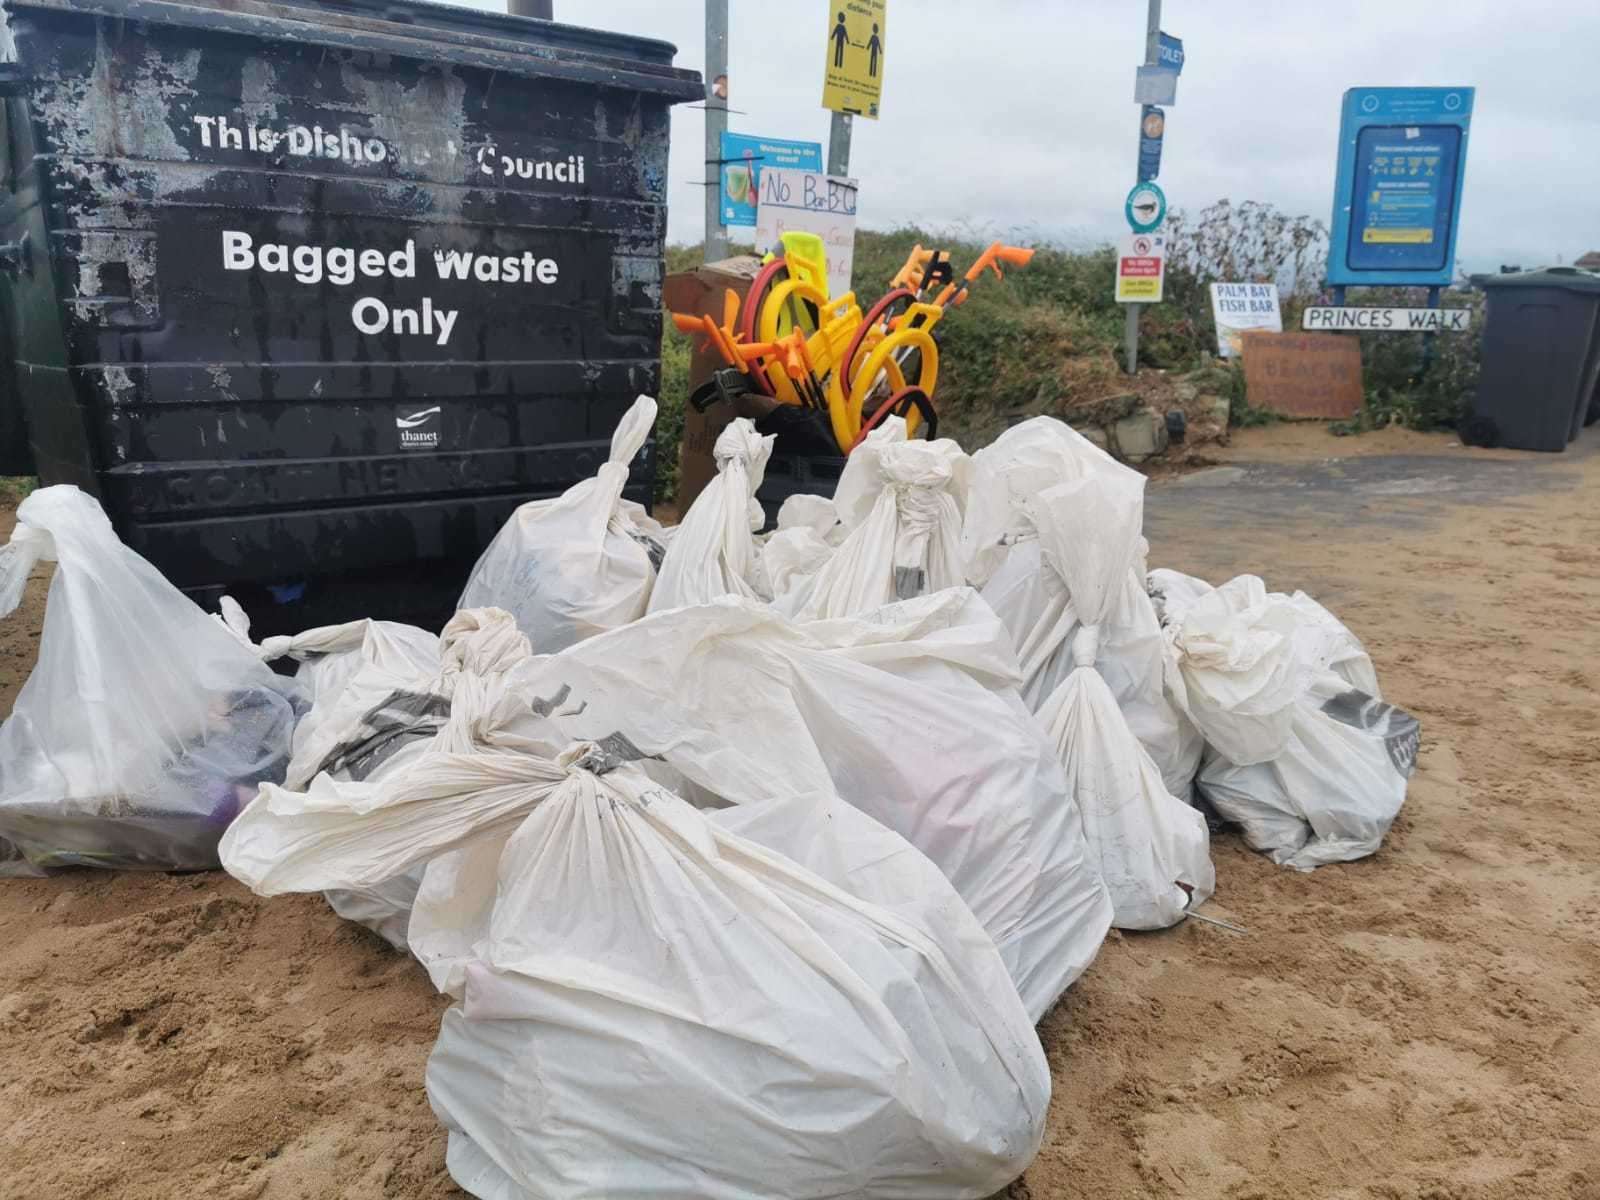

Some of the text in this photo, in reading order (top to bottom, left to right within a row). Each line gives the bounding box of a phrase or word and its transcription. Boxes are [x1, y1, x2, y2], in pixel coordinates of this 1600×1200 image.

[193, 115, 275, 153] This
[477, 146, 585, 184] Council
[766, 173, 791, 203] No
[221, 230, 417, 286] Bagged
[1217, 285, 1272, 298] PALM BAY
[1219, 299, 1274, 313] FISH BAR
[351, 298, 458, 345] Only
[1310, 310, 1465, 329] PRINCES WALK
[402, 430, 437, 441] thanet
